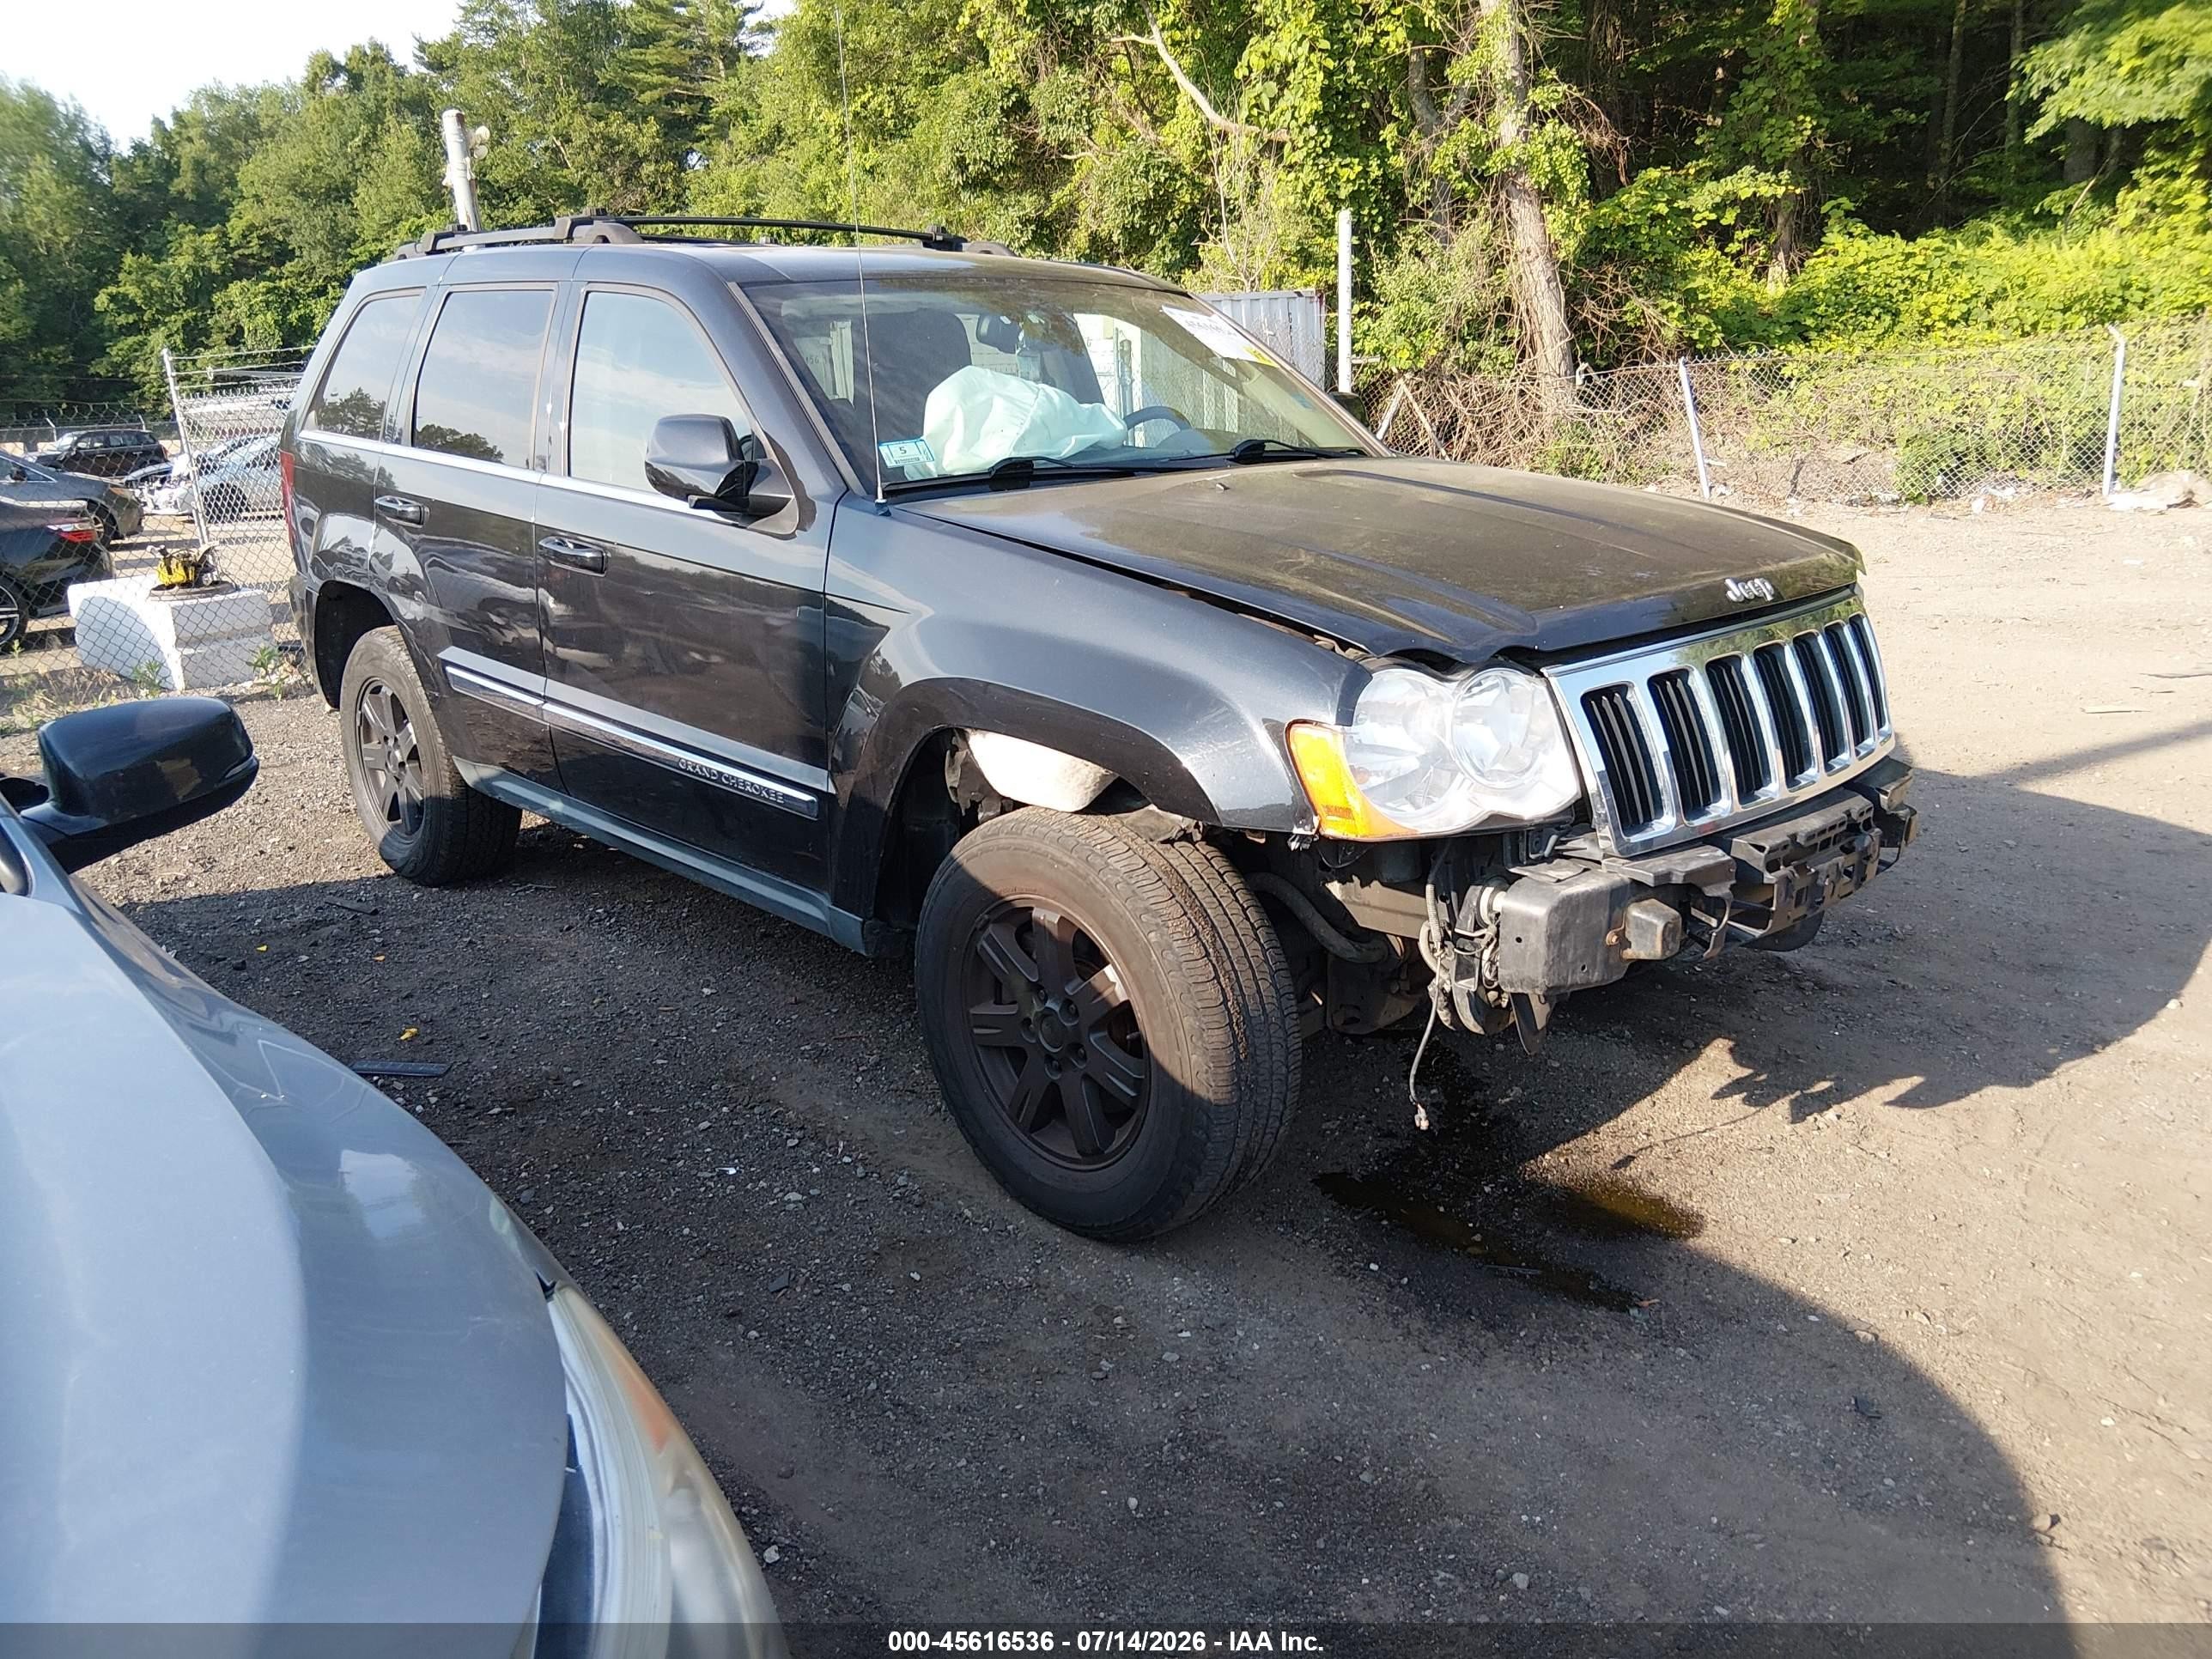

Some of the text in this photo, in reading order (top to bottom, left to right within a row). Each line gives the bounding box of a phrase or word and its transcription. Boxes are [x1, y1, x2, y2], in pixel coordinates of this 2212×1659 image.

[1724, 578, 1775, 603] Jeep
[678, 758, 785, 804] GRAND CHEROKEE
